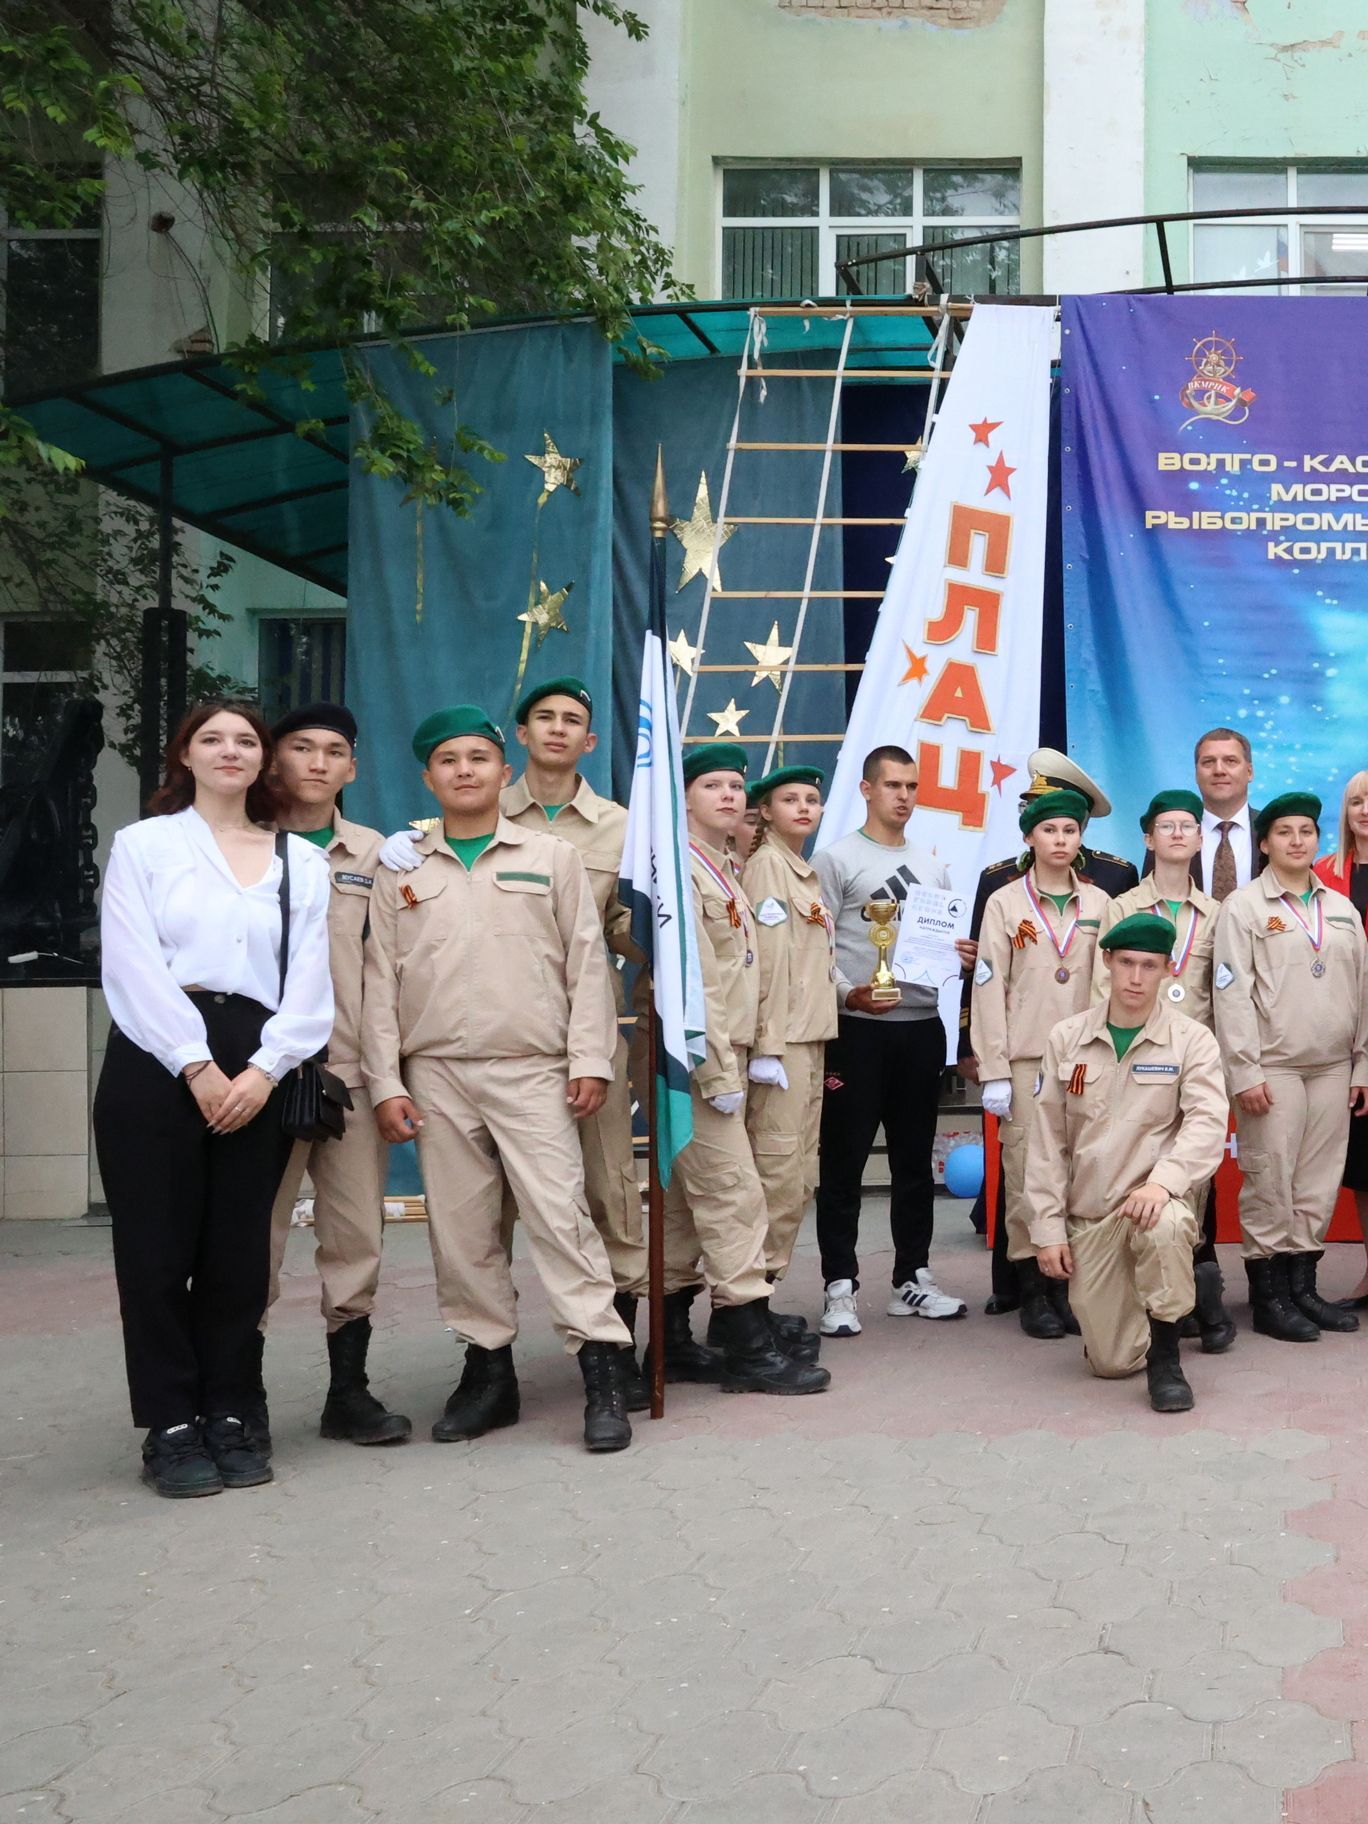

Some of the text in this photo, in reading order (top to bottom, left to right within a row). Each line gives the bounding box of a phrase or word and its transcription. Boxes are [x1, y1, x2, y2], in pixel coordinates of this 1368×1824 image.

[1157, 452, 1278, 473] ВОЛГО
[914, 500, 1013, 832] ПЛАЦ
[917, 916, 955, 930] ДИПЛОМ
